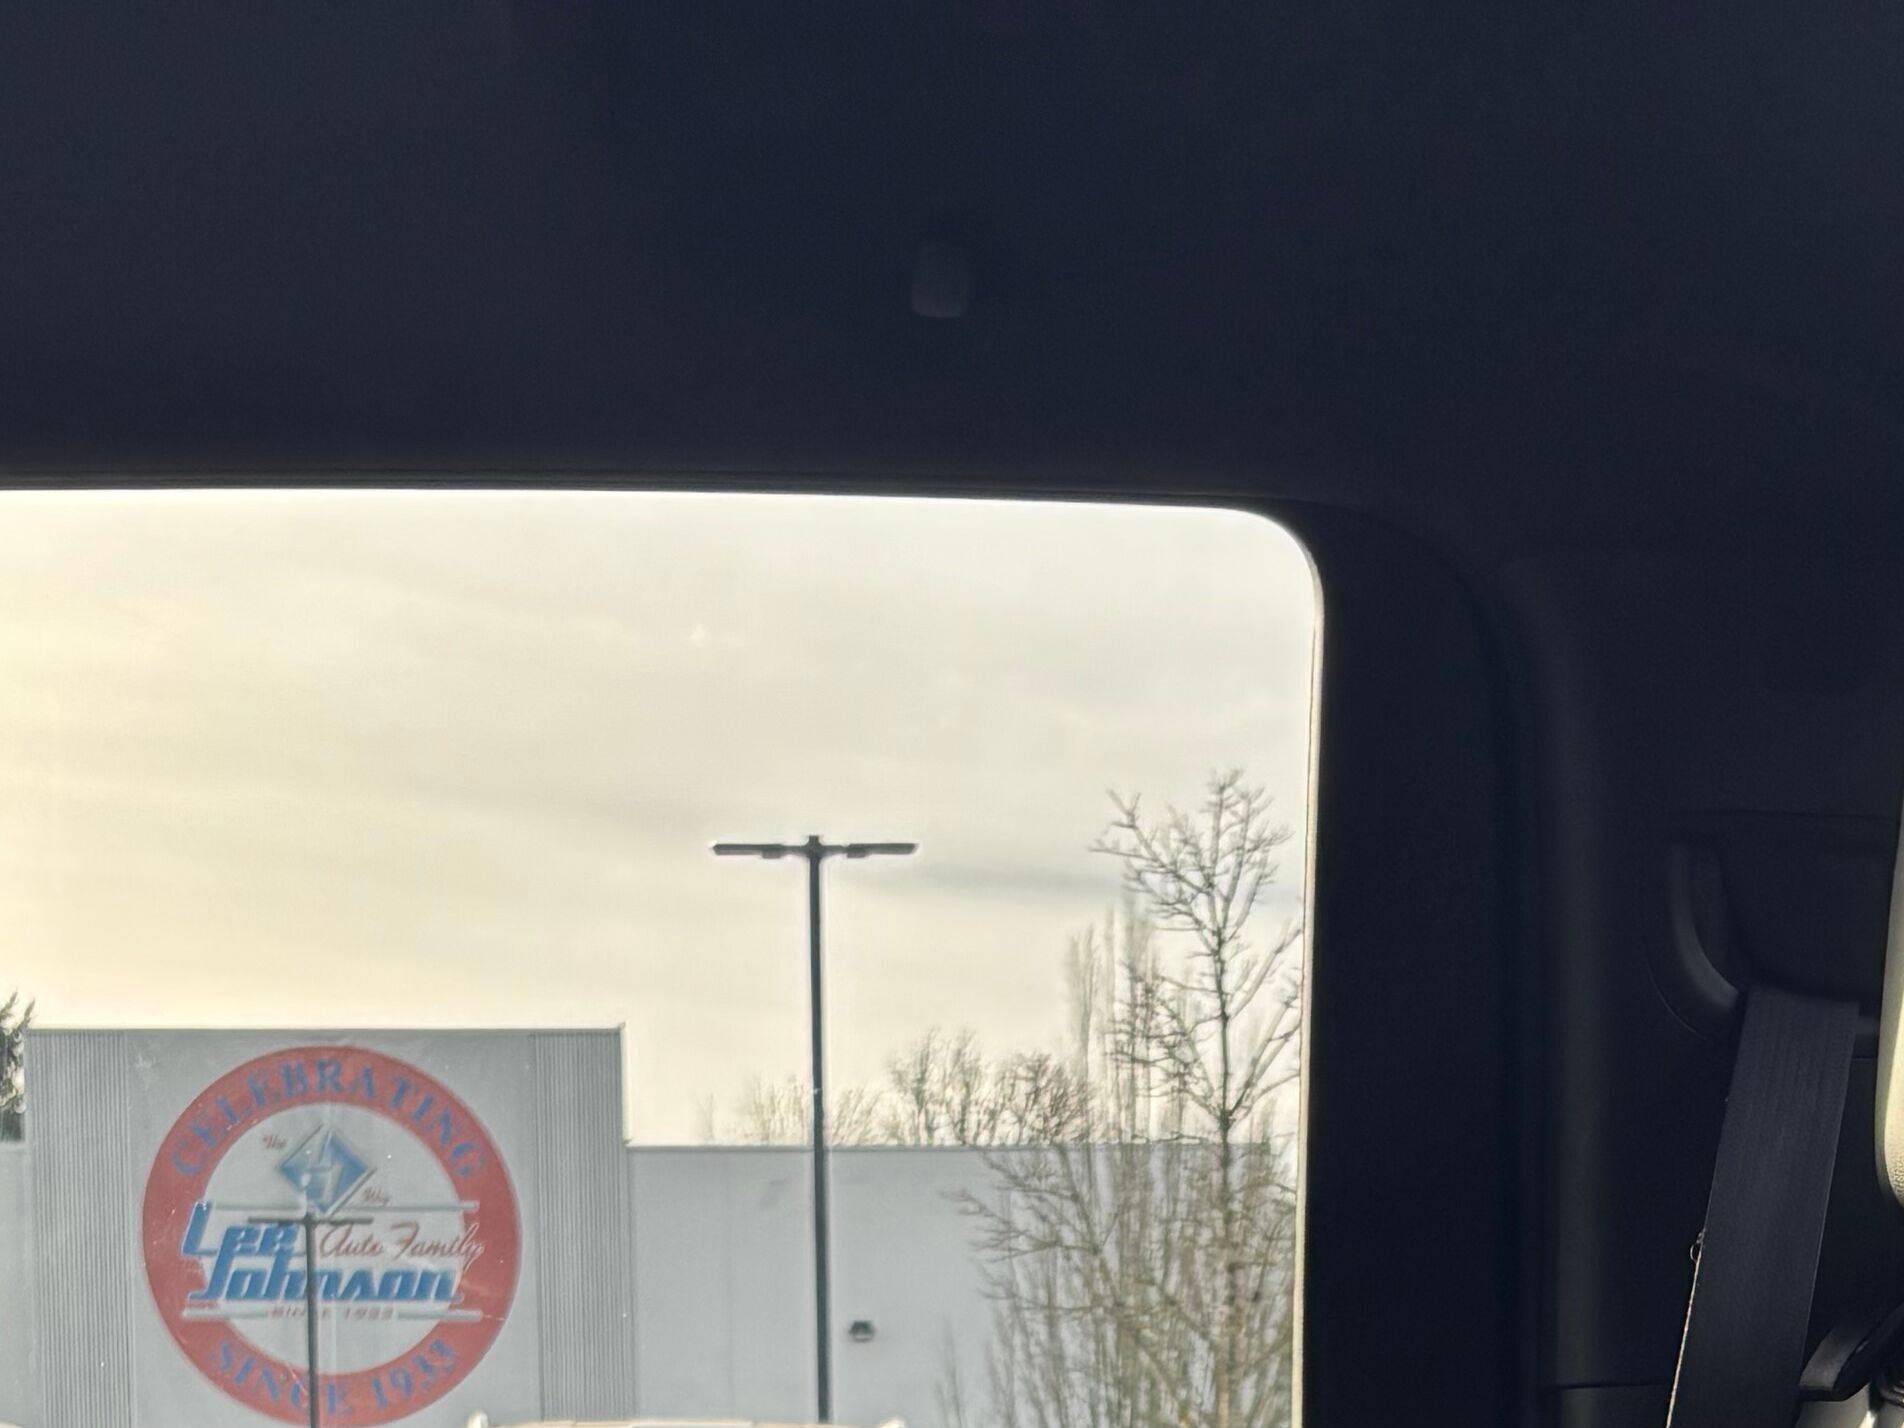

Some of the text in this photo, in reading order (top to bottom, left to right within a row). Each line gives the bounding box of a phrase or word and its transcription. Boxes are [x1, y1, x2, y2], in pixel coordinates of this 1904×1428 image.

[171, 1058, 486, 1177] CELEBRATING
[181, 1200, 487, 1273] Lee Auto Family
[188, 1226, 465, 1302] Johnson
[208, 1337, 459, 1416] SINCE 1933
